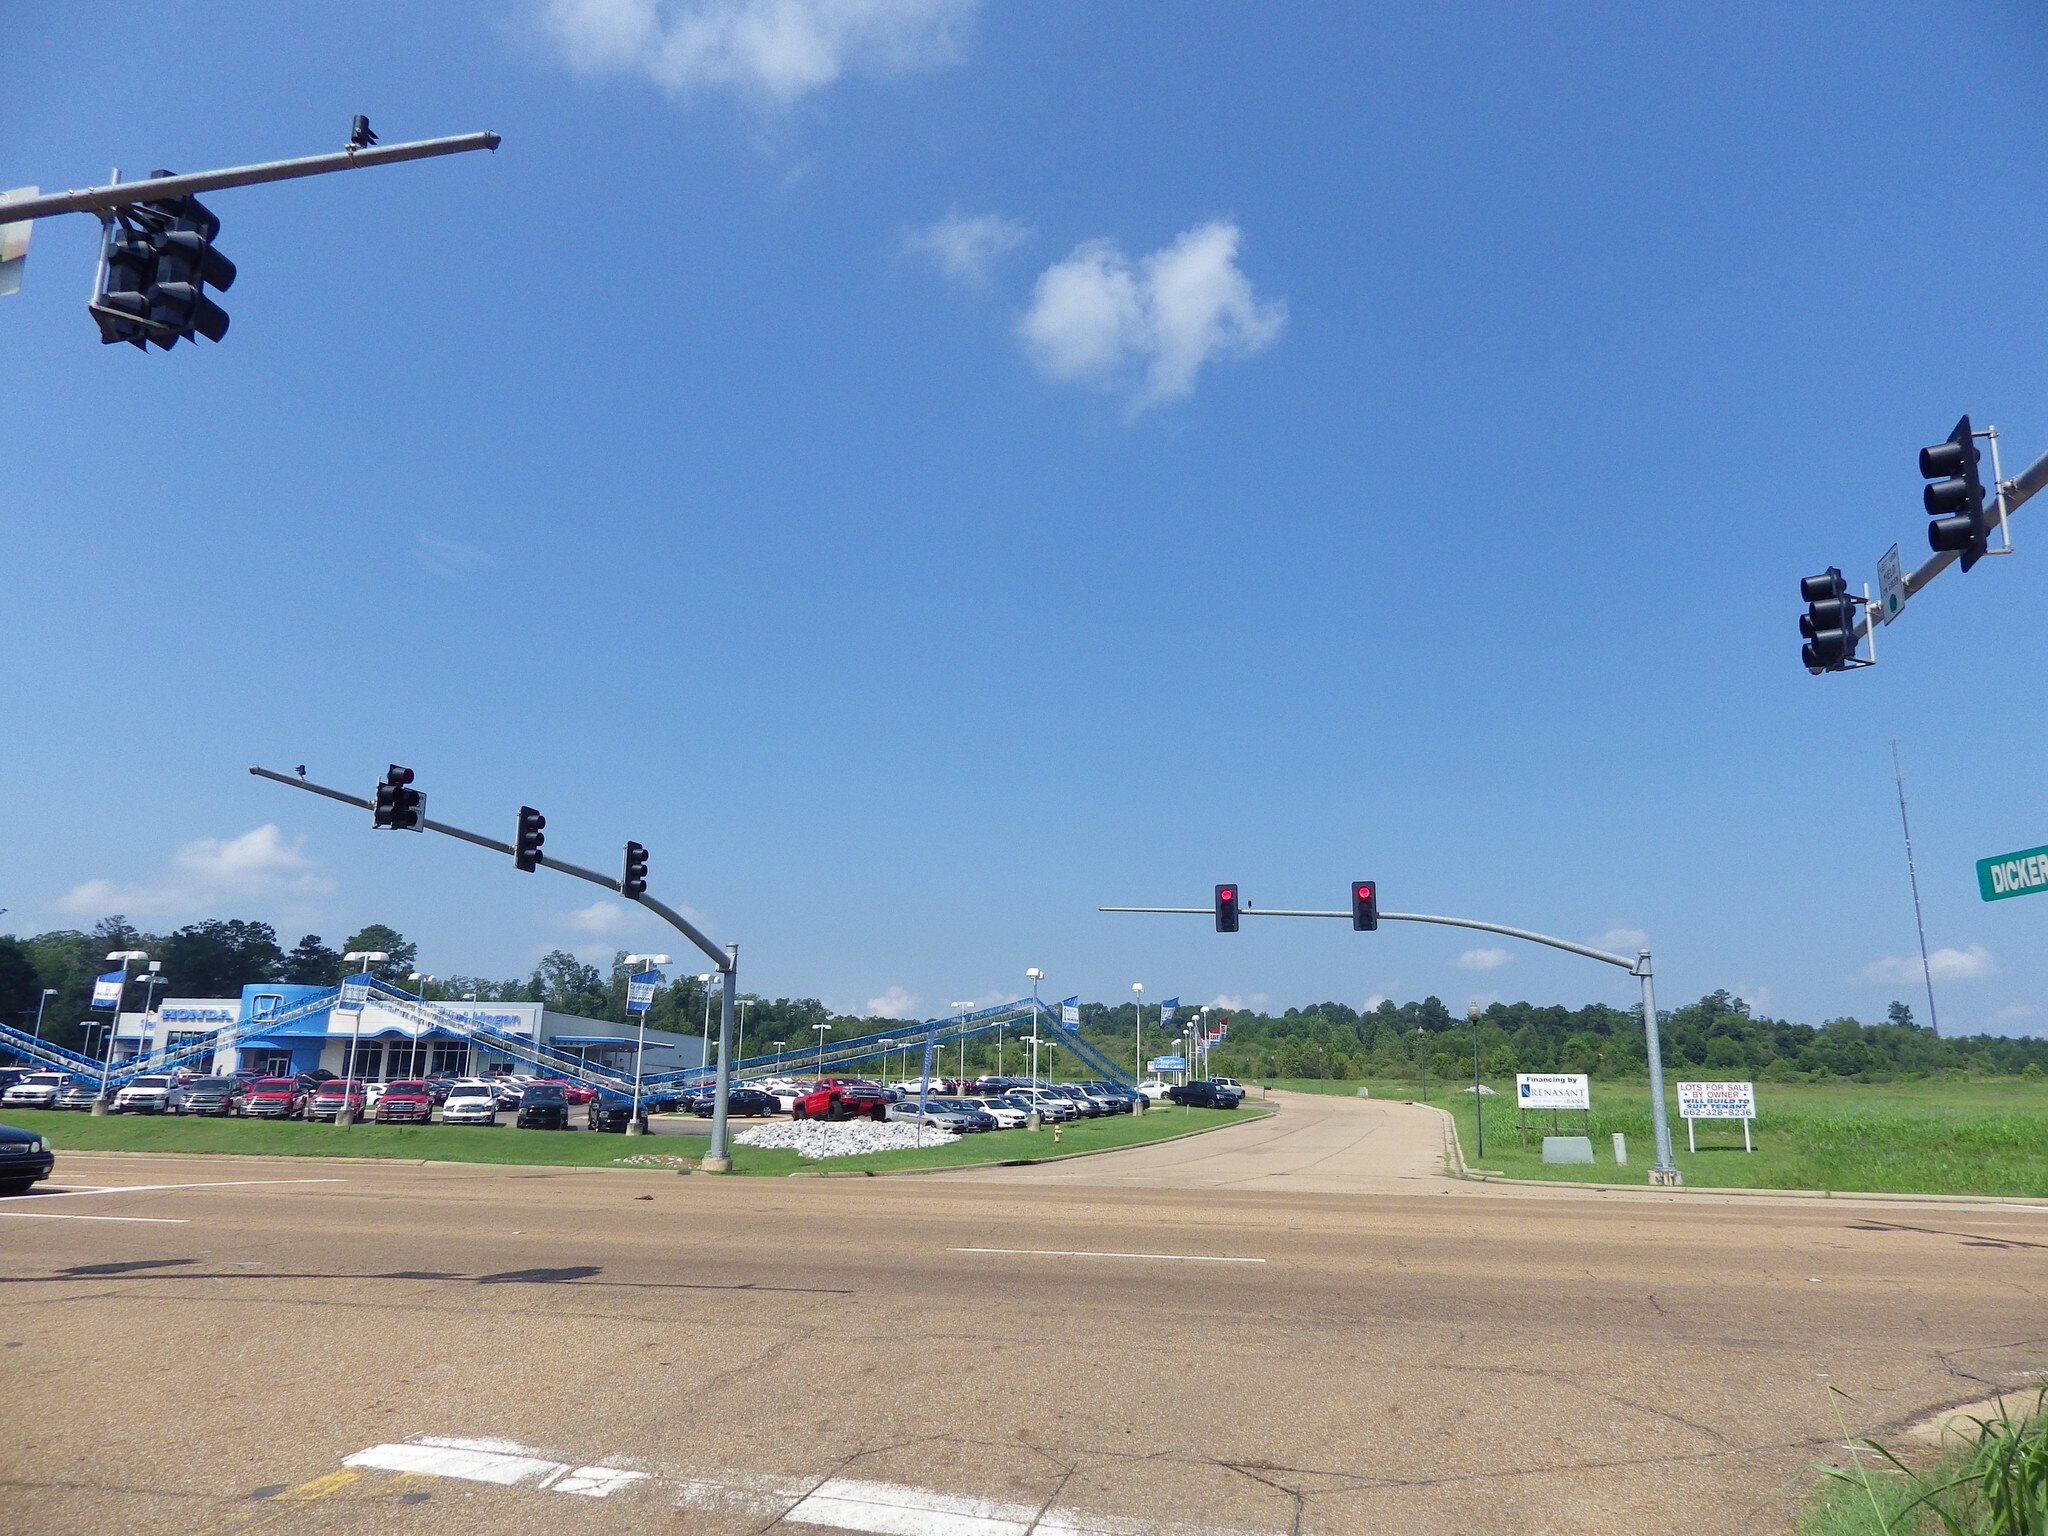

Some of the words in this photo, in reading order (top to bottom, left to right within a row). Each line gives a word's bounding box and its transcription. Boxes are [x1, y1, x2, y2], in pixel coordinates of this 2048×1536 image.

[161, 1009, 233, 1021] HONDA
[1680, 1083, 1703, 1091] LOTS
[1706, 1083, 1724, 1091] FOR
